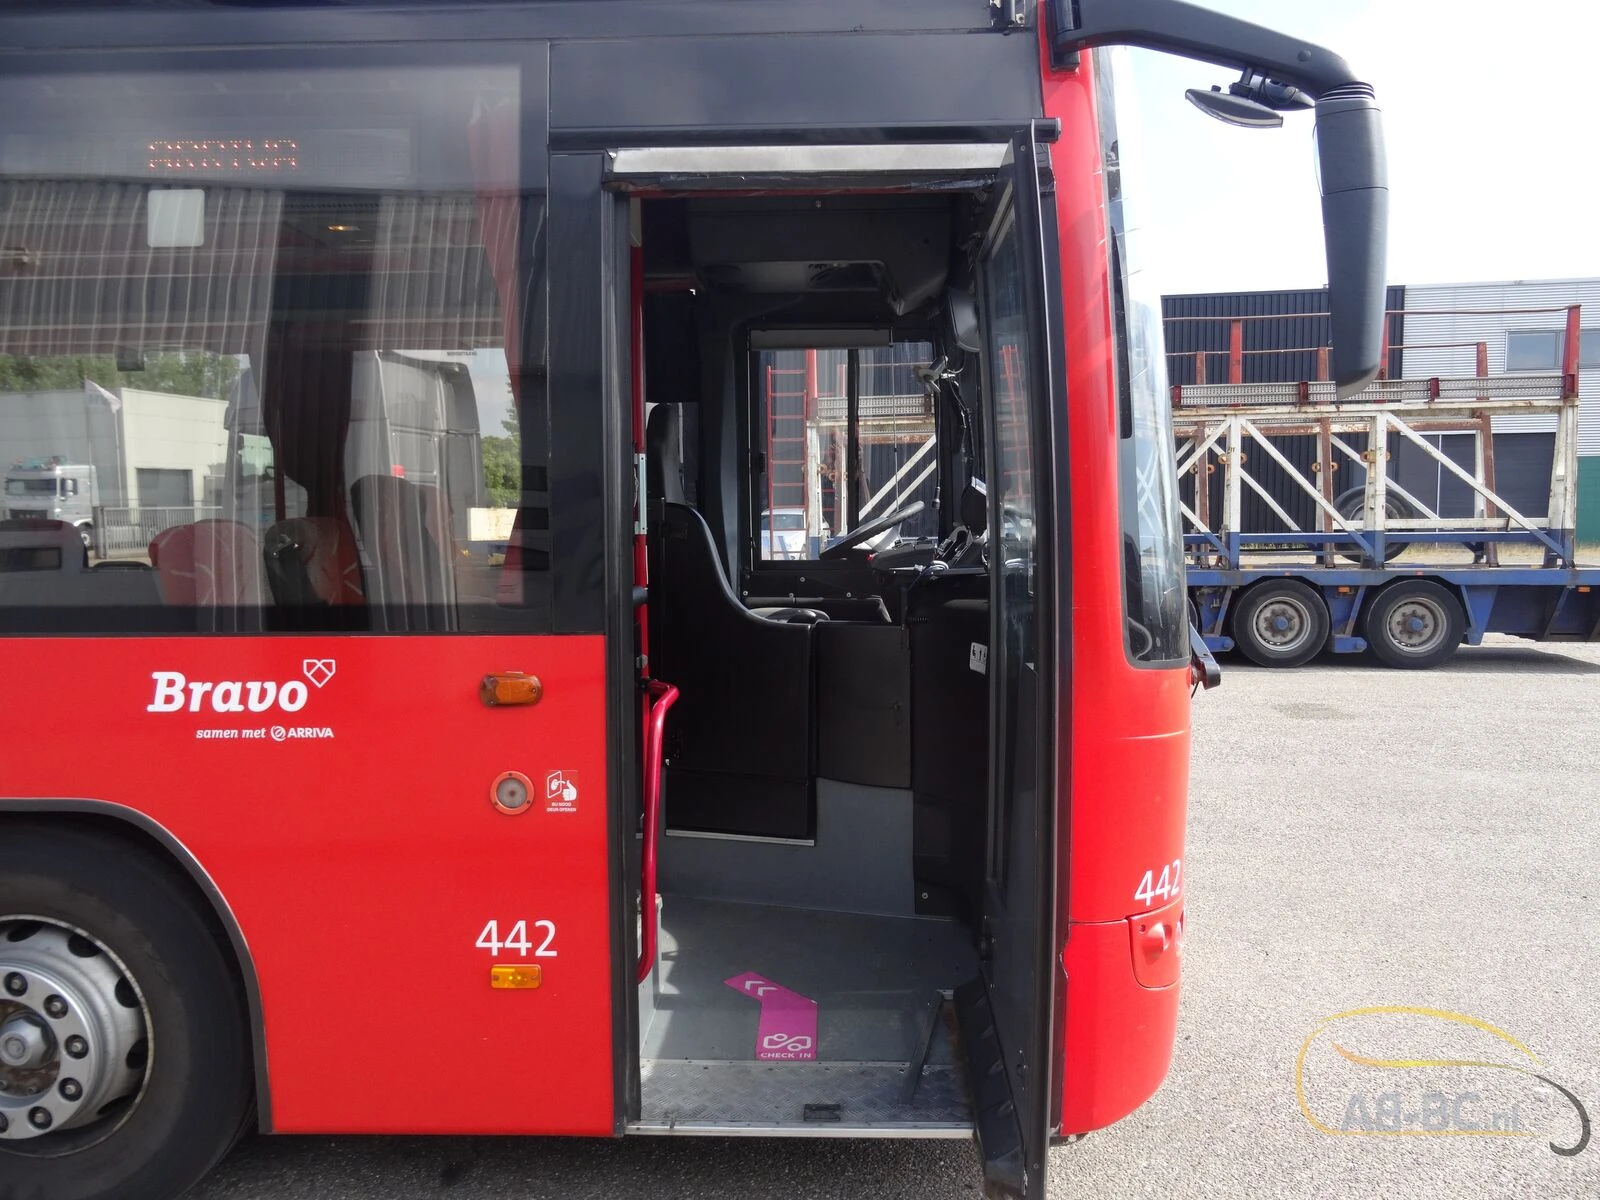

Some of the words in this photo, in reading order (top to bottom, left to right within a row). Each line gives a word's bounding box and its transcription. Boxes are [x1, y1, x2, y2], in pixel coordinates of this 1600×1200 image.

[147, 671, 308, 713] Bravo
[196, 728, 239, 739] samen
[241, 728, 267, 739] met
[286, 727, 335, 738] ARRIVA
[1134, 859, 1181, 906] 442
[475, 919, 558, 957] 442
